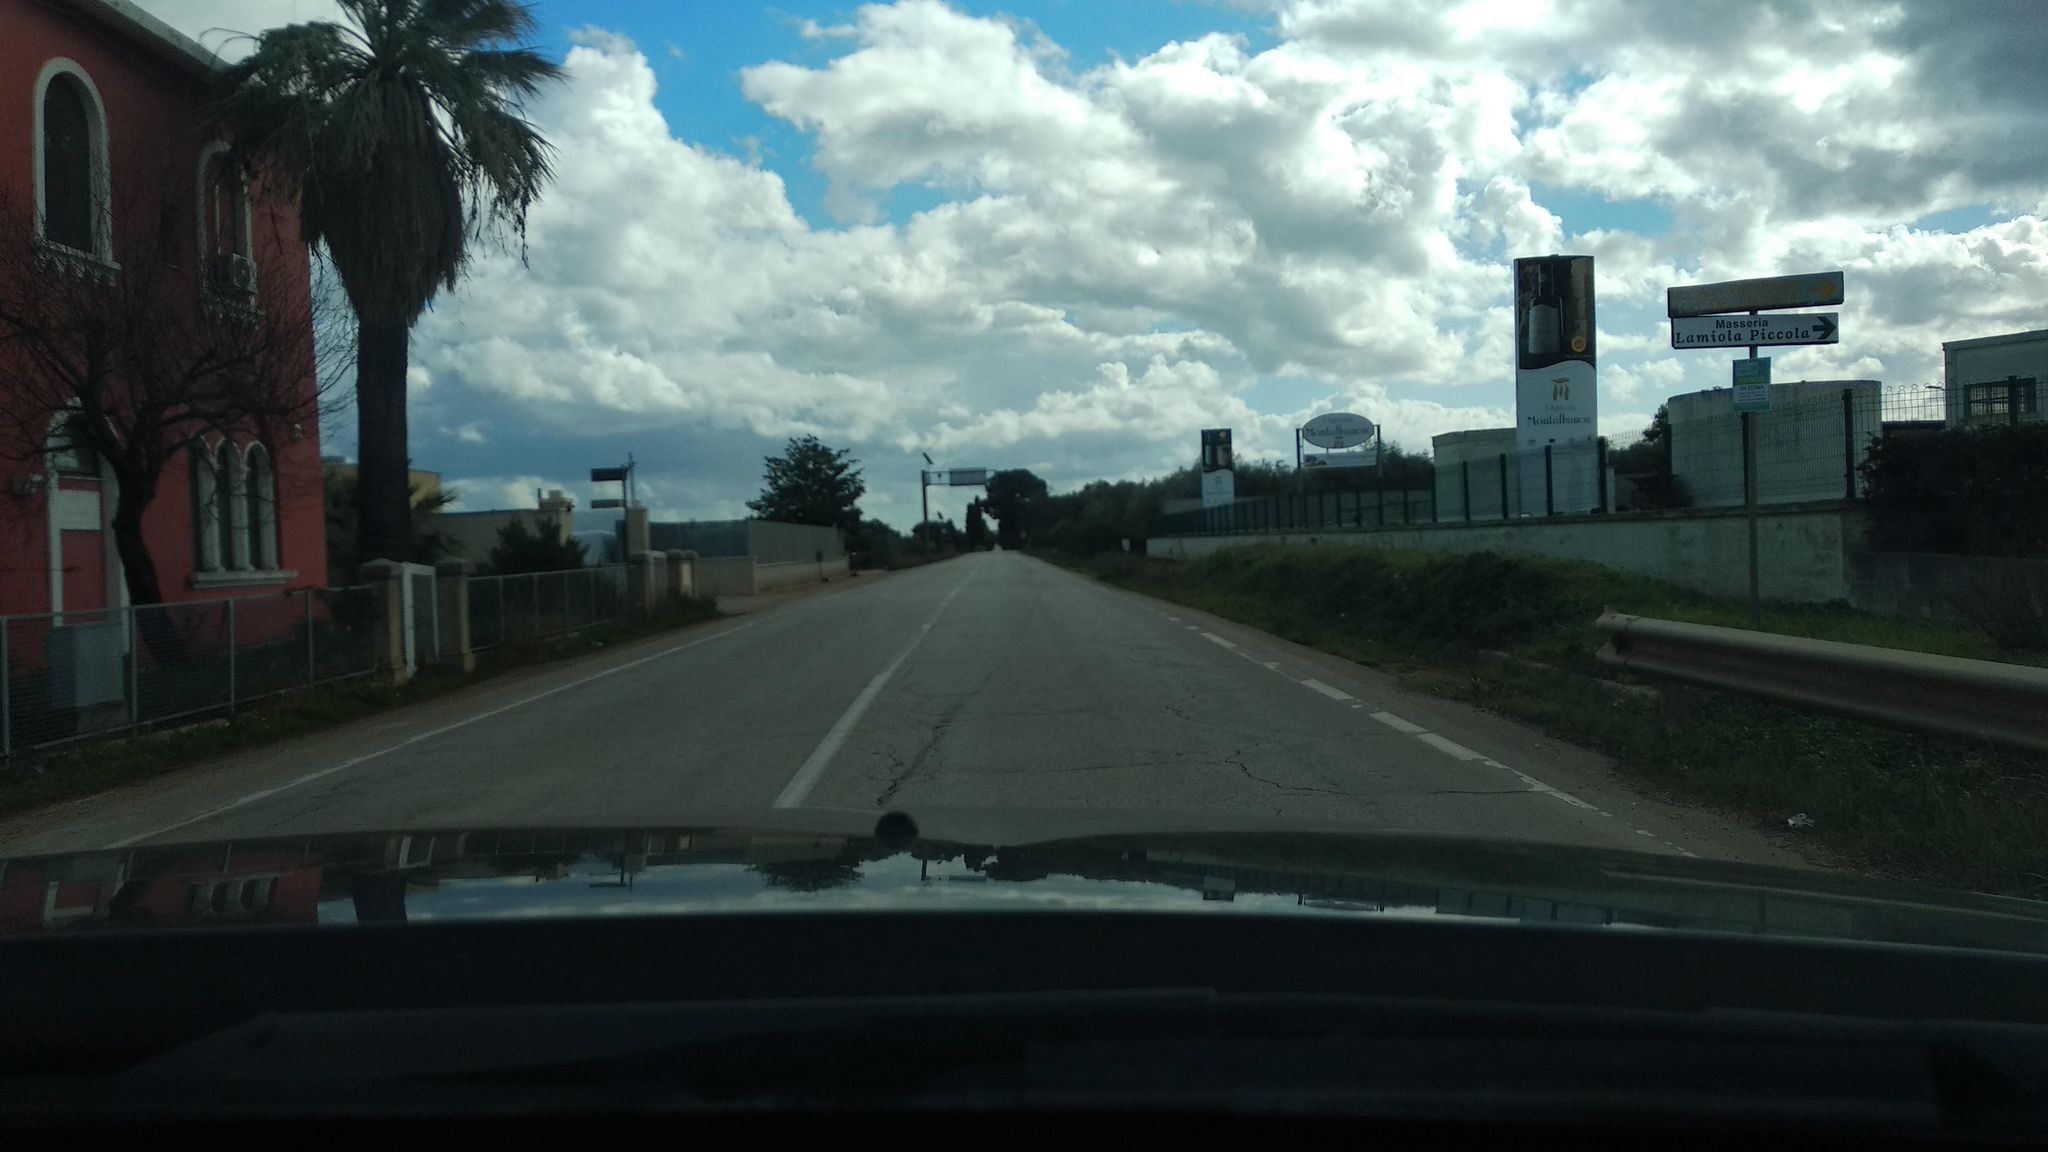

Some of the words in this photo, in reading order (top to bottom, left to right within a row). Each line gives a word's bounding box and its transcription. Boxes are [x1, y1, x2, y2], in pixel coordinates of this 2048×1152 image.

[1716, 317, 1768, 329] Masseria
[1675, 330, 1742, 344] Lamiola
[1749, 326, 1810, 341] Piccola
